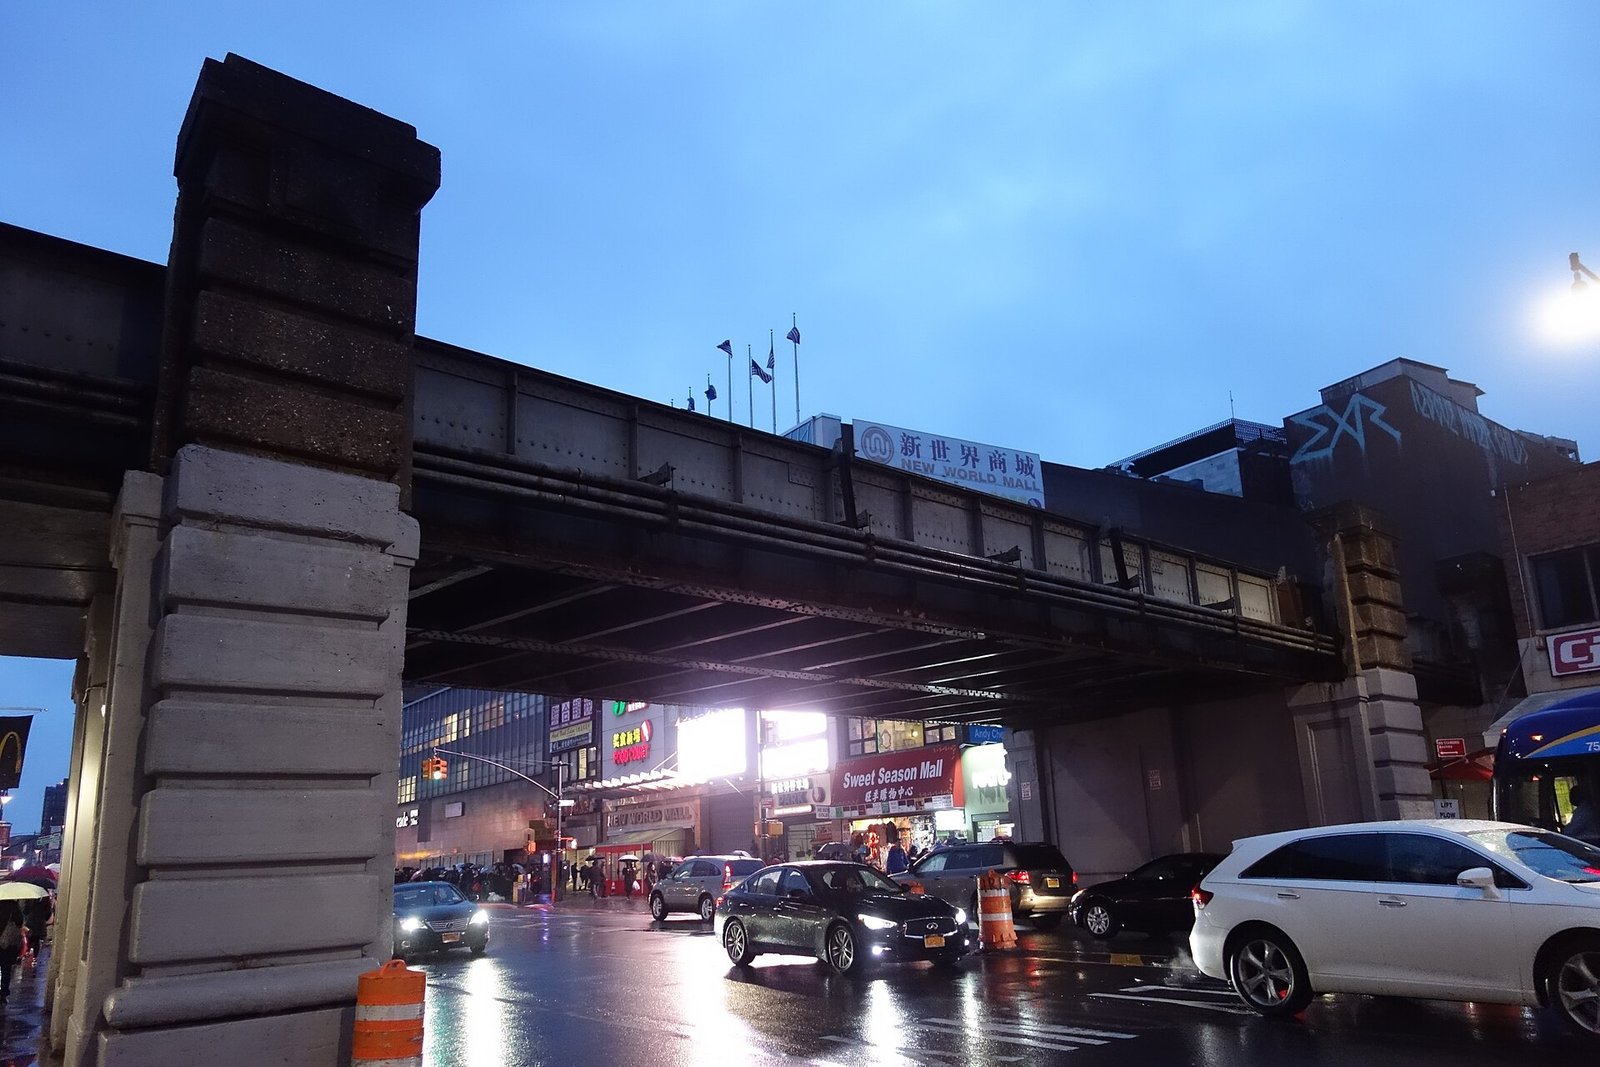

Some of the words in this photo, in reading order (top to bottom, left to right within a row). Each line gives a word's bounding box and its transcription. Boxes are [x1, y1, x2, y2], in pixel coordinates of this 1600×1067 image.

[900, 431, 1036, 479] 新世界商城
[901, 458, 935, 474] NEW
[944, 466, 997, 484] WORLD
[1003, 476, 1041, 492] MALL
[974, 727, 990, 742] Andy
[843, 771, 876, 789] Sweet
[877, 766, 917, 785] Season
[920, 759, 943, 779] Mall
[607, 813, 628, 828] NEW
[629, 810, 663, 825] WORLD
[663, 806, 693, 821] MALL
